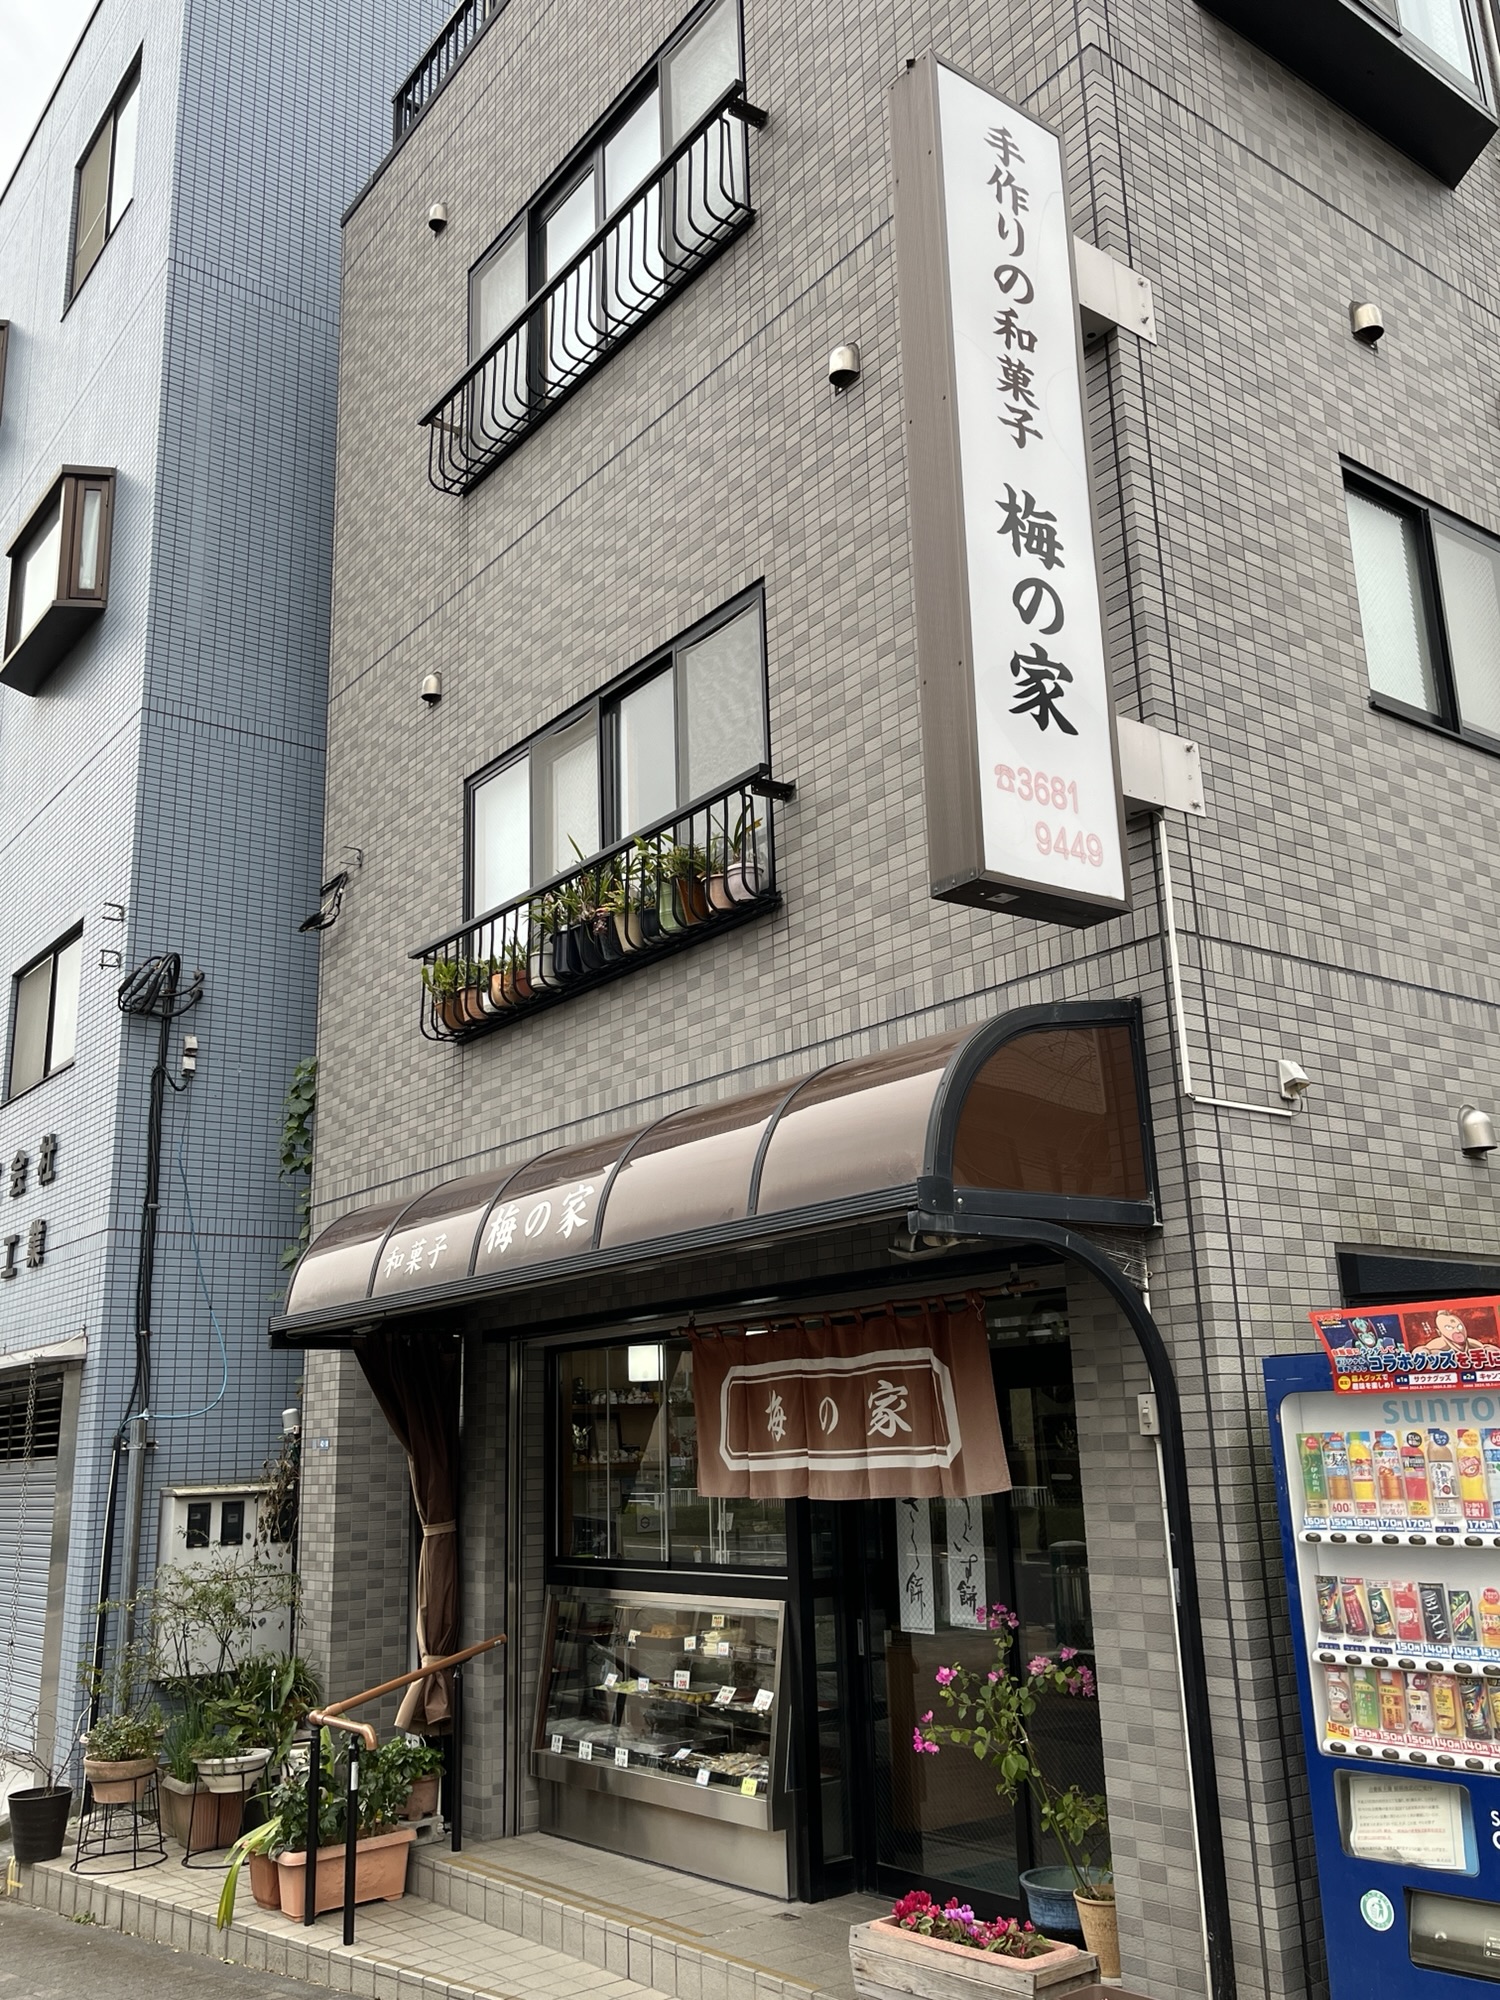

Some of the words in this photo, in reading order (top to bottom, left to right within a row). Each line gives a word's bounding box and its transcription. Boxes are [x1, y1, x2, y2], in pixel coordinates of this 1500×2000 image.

[983, 126, 1043, 450] 手作りの和菓子
[995, 483, 1079, 736] 梅の家
[1017, 767, 1080, 814] 3681
[1035, 821, 1103, 868] 9449
[0, 1133, 57, 1197] 会社
[1, 1219, 46, 1279] 工業
[383, 1233, 448, 1279] 和菓子
[484, 1183, 595, 1254] 梅の家
[1480, 1372, 1500, 1380] キャン
[1382, 1396, 1500, 1424] SUNTO
[1424, 1596, 1448, 1639] BLACK
[1480, 1647, 1500, 1656] 150
